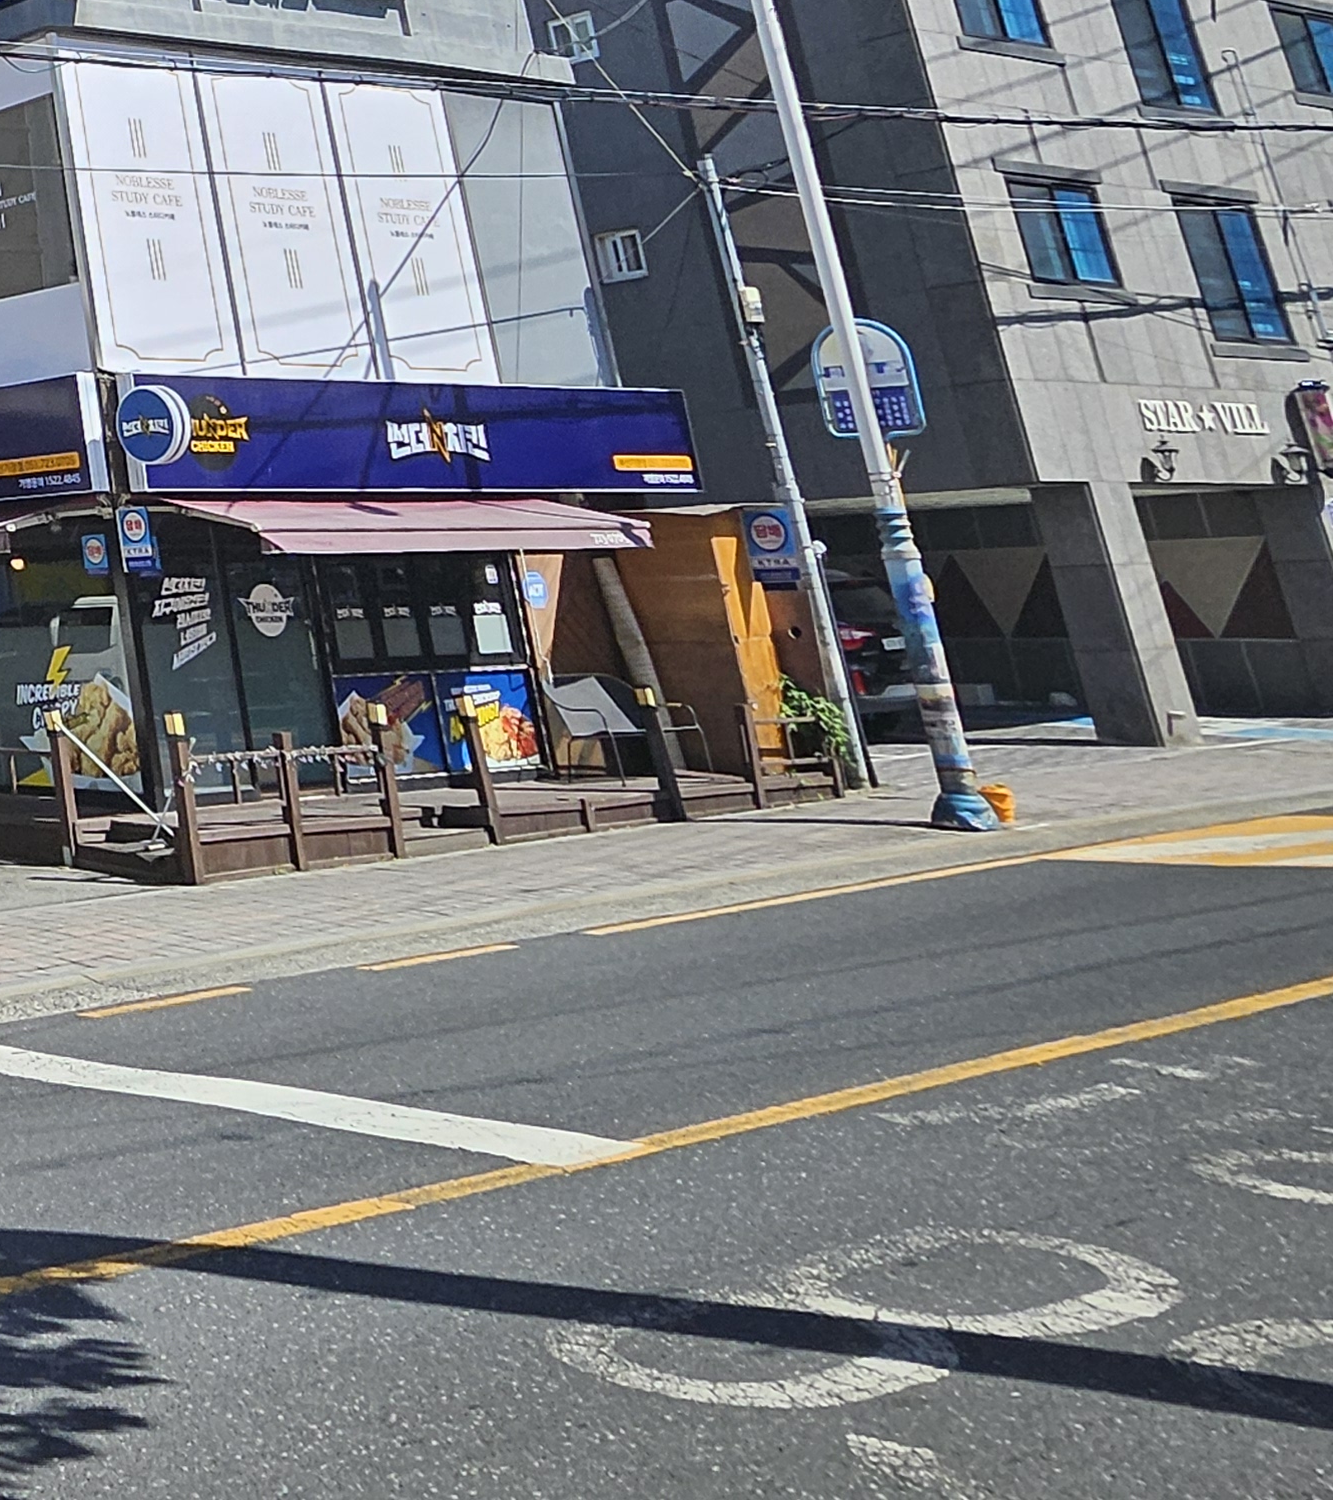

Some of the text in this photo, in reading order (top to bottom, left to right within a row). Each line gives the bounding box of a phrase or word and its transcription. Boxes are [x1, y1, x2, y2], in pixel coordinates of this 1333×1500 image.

[114, 174, 175, 191] NOBLESSE
[110, 190, 183, 208] STUDY CAFE
[251, 186, 309, 202] NOBLESSE
[248, 202, 317, 218] STUDY CAFE
[380, 198, 434, 213] NOBLESSE
[377, 213, 412, 227] STUDY
[1138, 399, 1271, 435] STAR VILL
[189, 413, 250, 440] UNDER
